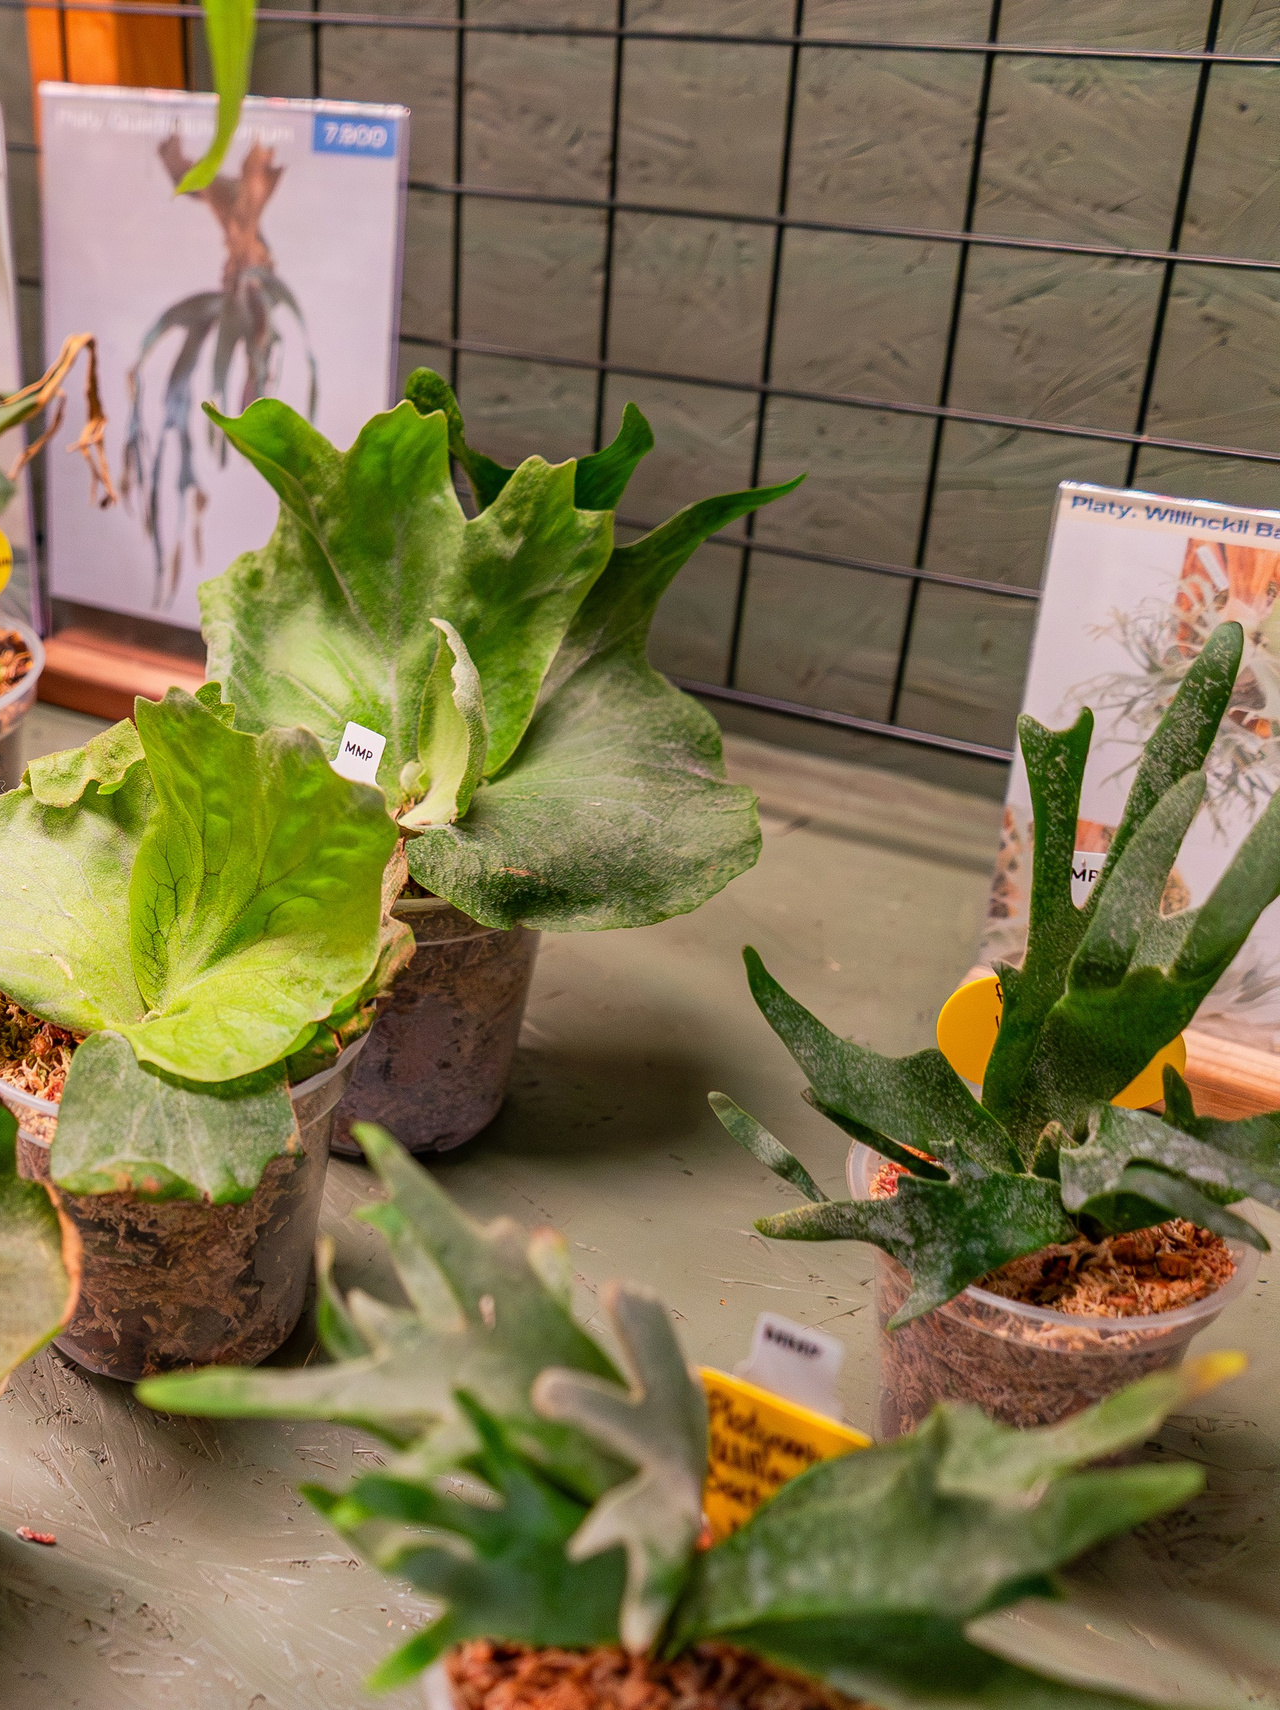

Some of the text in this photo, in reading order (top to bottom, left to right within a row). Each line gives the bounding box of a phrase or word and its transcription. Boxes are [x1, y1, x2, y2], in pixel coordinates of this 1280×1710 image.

[1071, 495, 1136, 520] Platy.
[344, 740, 373, 761] MMP
[1072, 867, 1098, 882] MP
